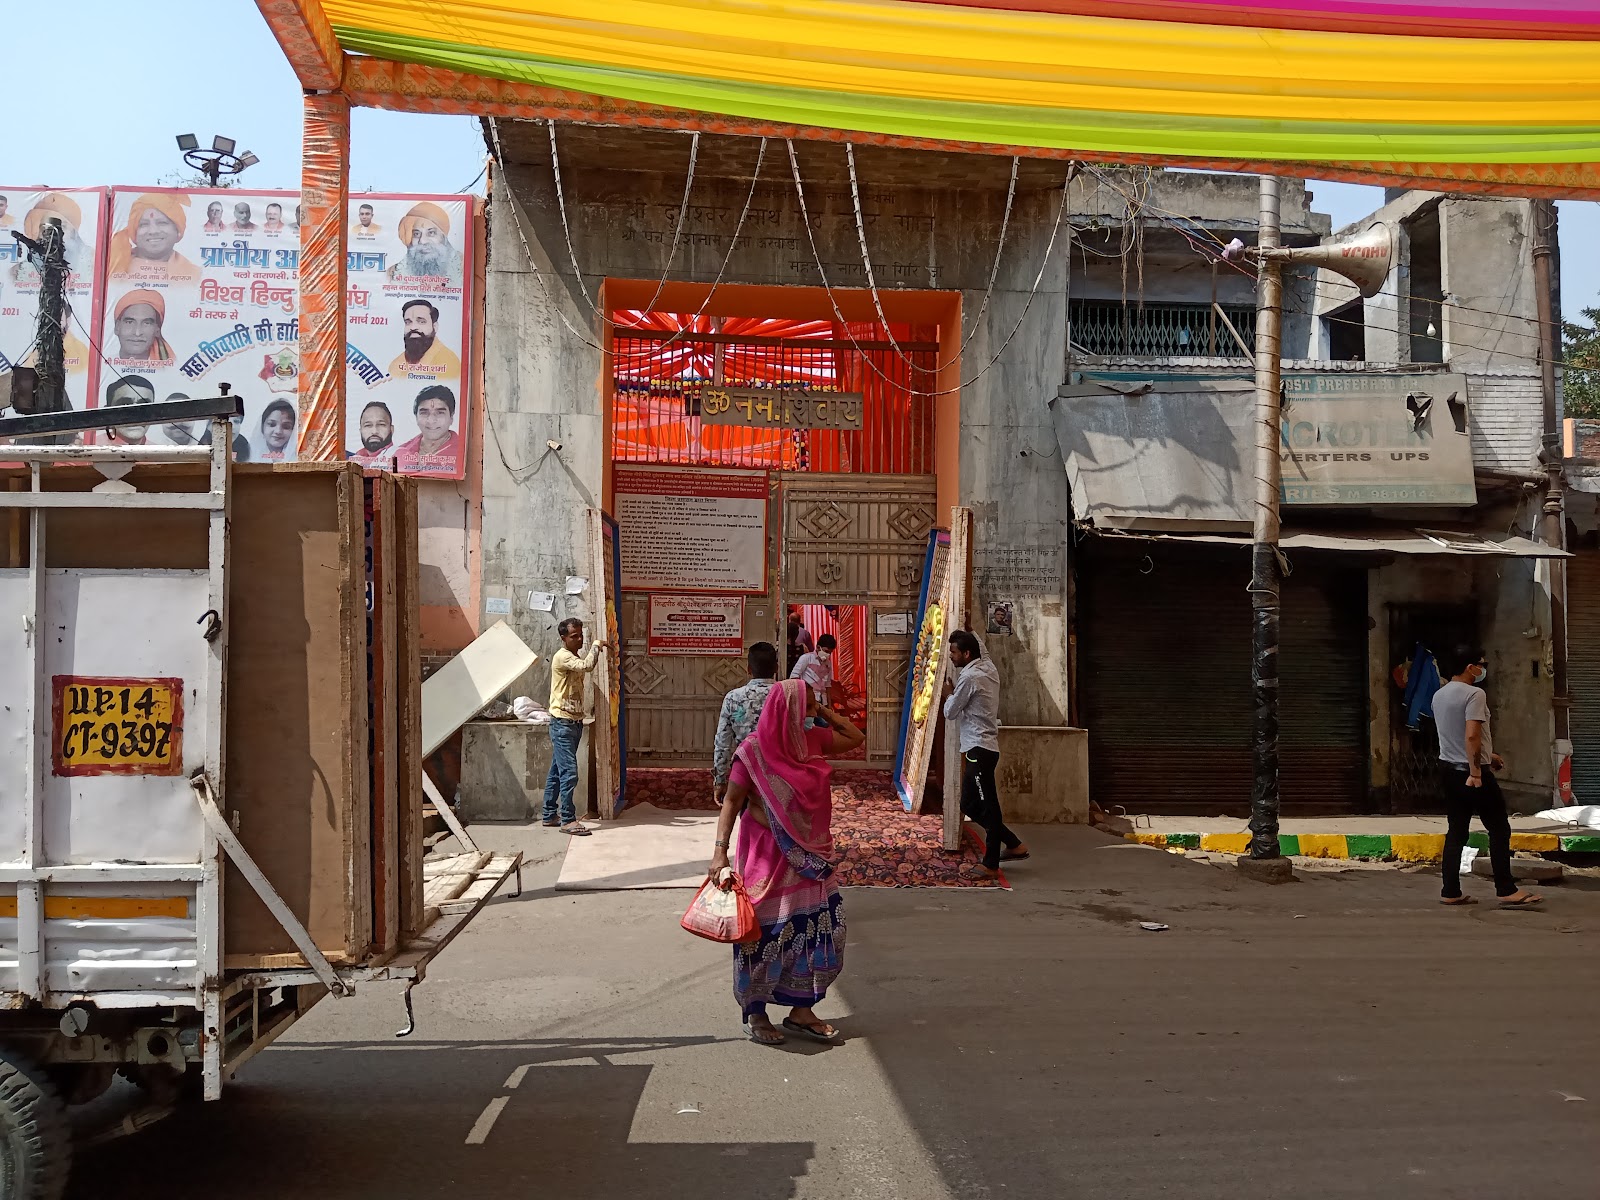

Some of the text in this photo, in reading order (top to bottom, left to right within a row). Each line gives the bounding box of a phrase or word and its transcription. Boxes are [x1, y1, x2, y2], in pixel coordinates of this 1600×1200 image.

[200, 240, 271, 268] प्रांतीय
[233, 270, 251, 279] चलो
[200, 279, 246, 303] विश्व
[1, 307, 20, 316] 2021
[189, 307, 389, 326] की तरफ से मार्च 2021
[179, 352, 209, 378] महा
[198, 323, 254, 363] शिवरात्रि
[254, 318, 273, 342] की
[408, 364, 429, 372] राजेश
[431, 364, 447, 373] शर्मा
[782, 388, 864, 428] शिवाय
[1390, 452, 1430, 462] UPS
